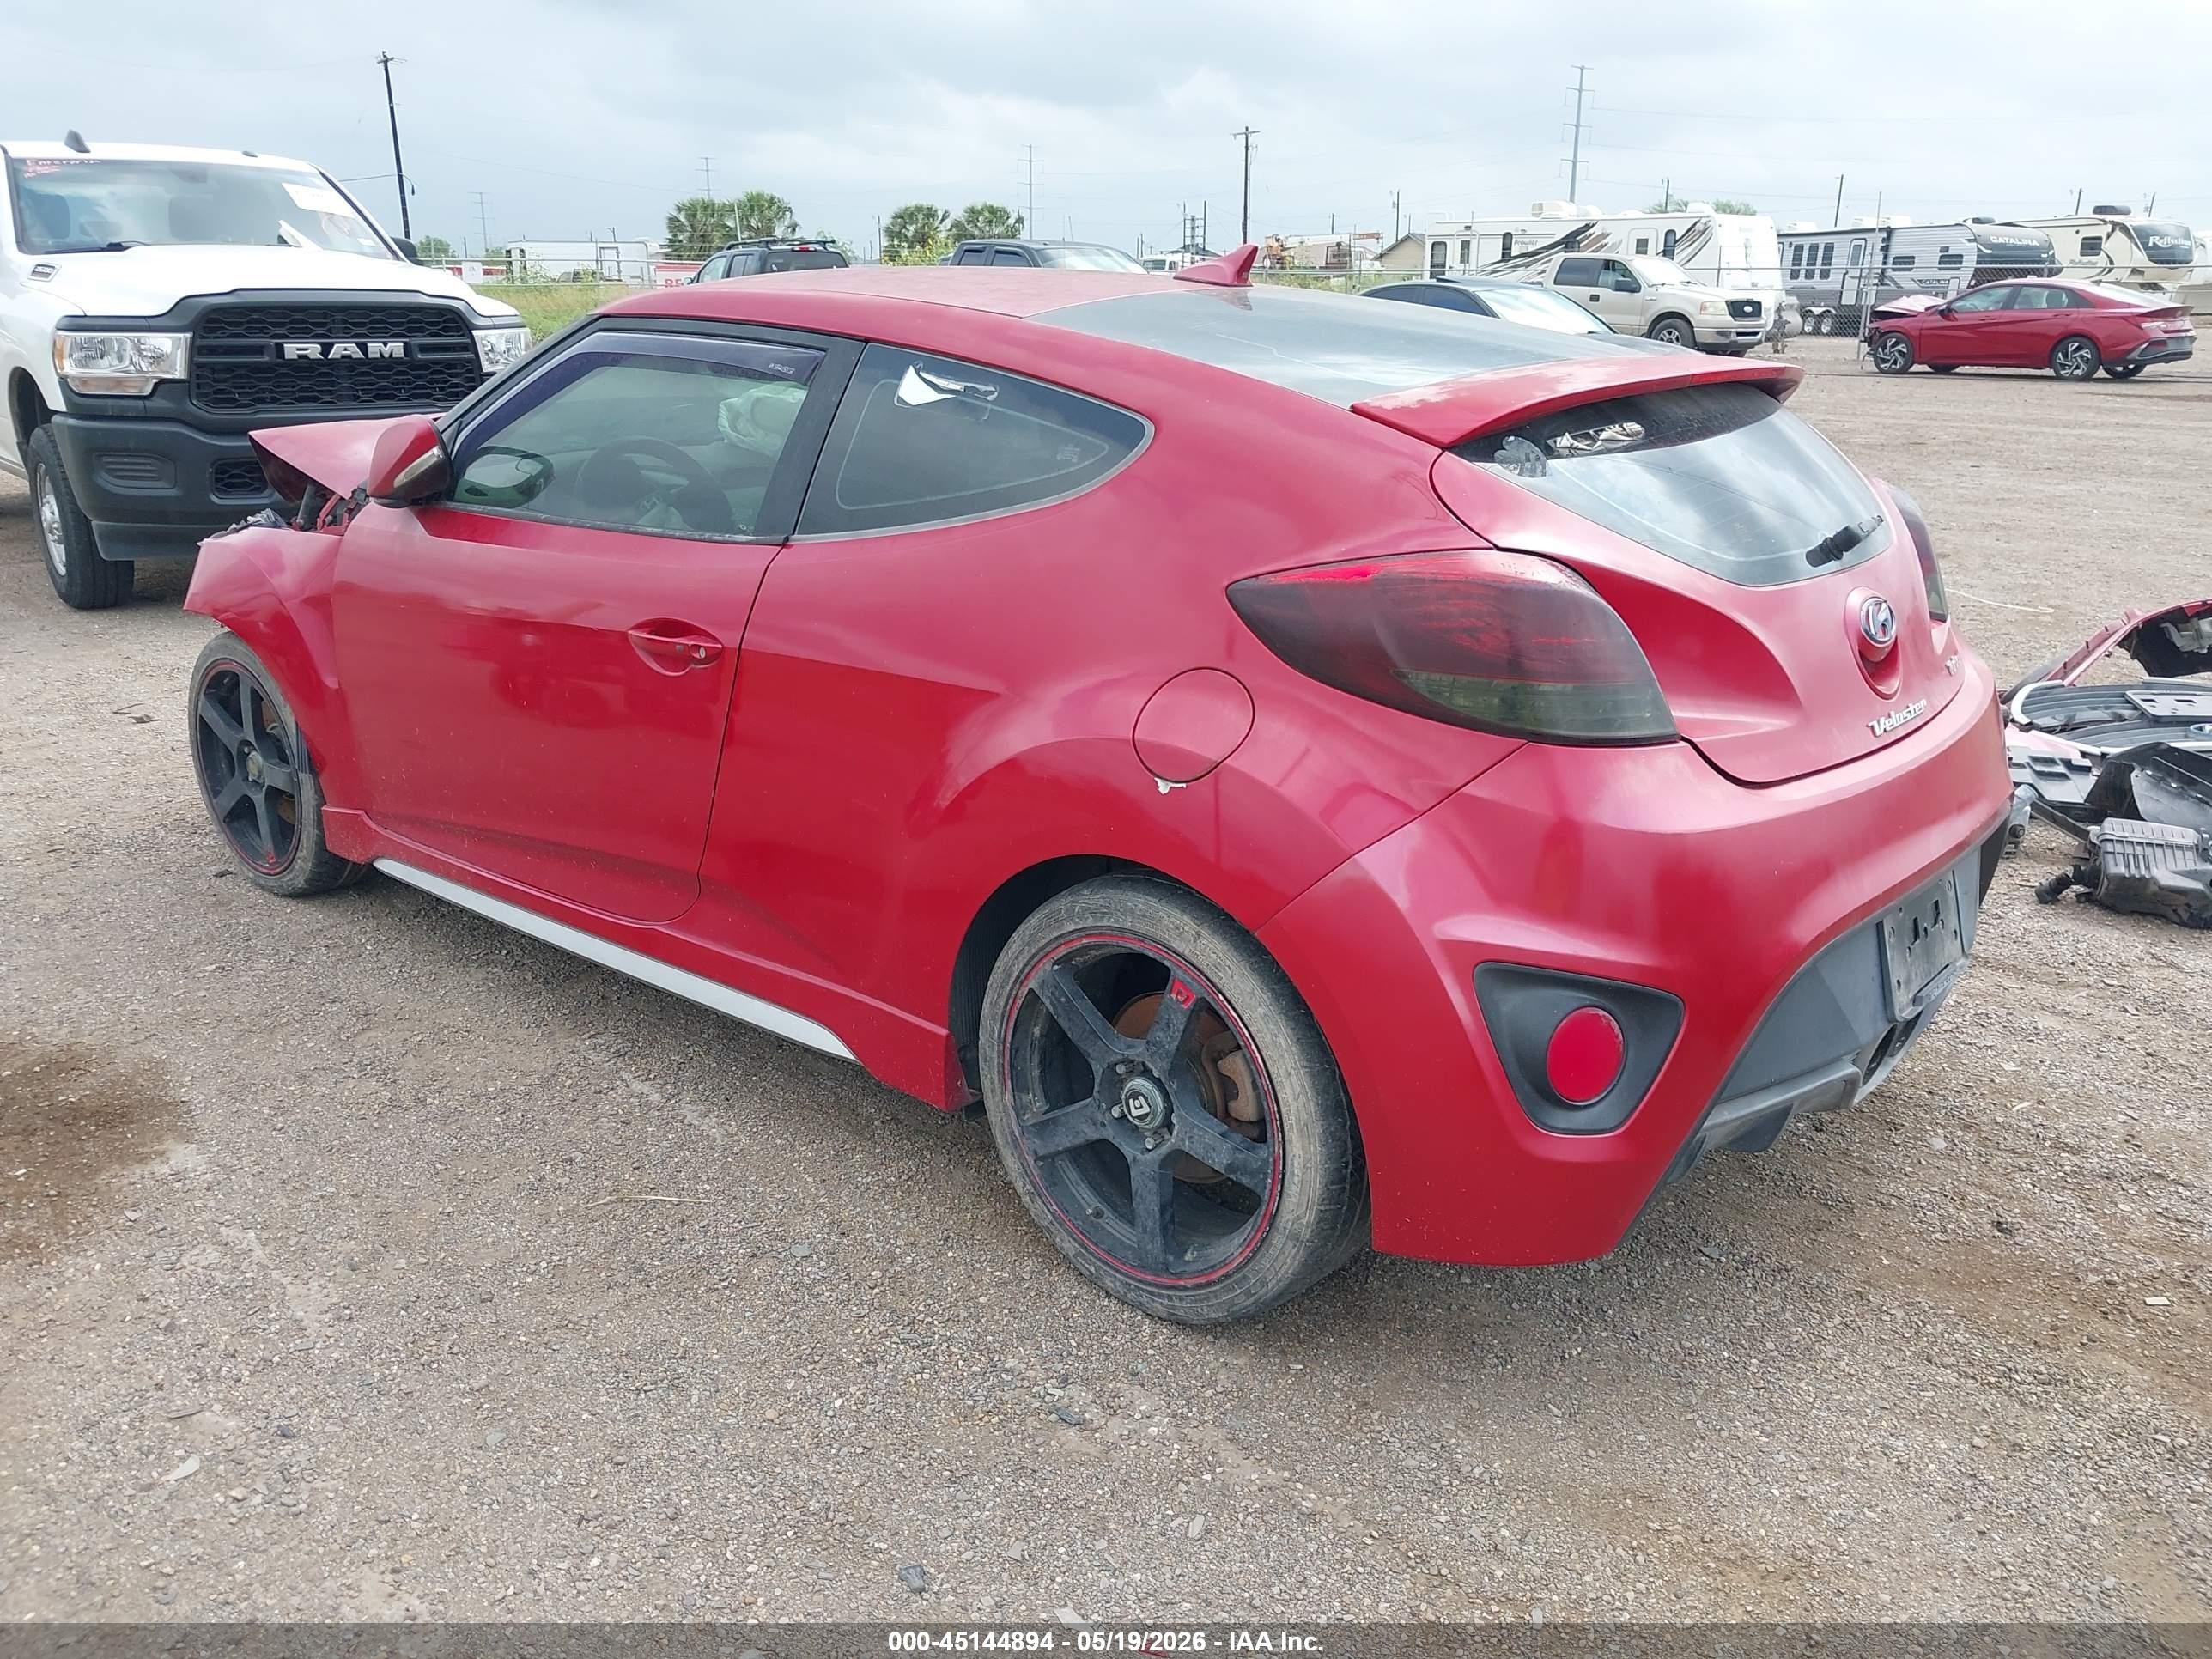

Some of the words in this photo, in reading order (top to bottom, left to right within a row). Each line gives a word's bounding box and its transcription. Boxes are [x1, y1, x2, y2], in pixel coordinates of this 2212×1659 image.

[1990, 235, 2040, 246] CATALINA
[283, 343, 404, 359] RAM
[1867, 698, 1927, 737] Veloster
